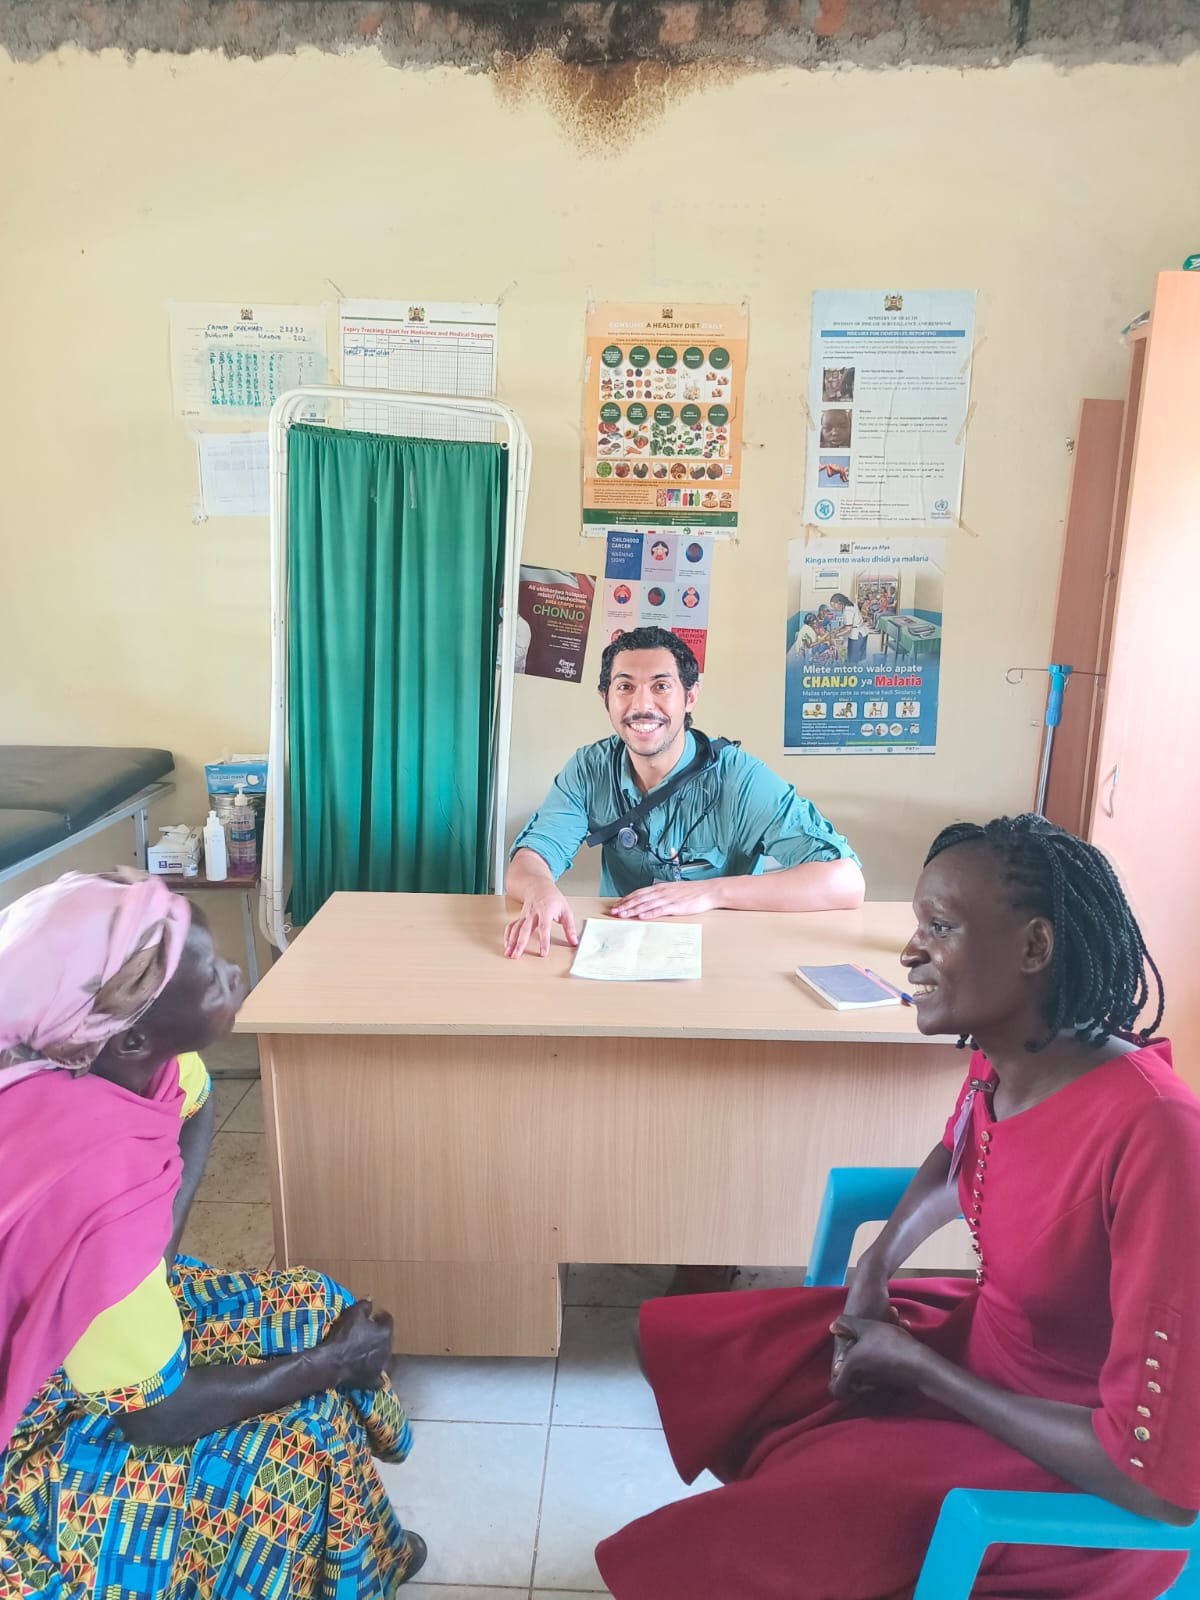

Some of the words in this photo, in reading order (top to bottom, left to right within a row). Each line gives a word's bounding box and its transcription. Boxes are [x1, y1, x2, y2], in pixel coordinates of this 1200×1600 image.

[343, 326, 361, 334] Expiry
[361, 327, 385, 335] Tracking
[471, 331, 494, 339] Supplies
[611, 536, 640, 544] CHILDHOOD
[805, 556, 826, 565] Kinga
[827, 556, 850, 564] mtoto
[871, 555, 891, 563] dhidi
[891, 556, 900, 564] ya
[532, 604, 585, 621] CHONJO
[803, 664, 831, 674] Mlete
[834, 664, 863, 673] mtoto
[866, 664, 892, 673] wako
[895, 664, 922, 674] apate
[802, 675, 858, 688] CHANJO
[860, 678, 873, 687] ya
[874, 674, 922, 687] Malaria
